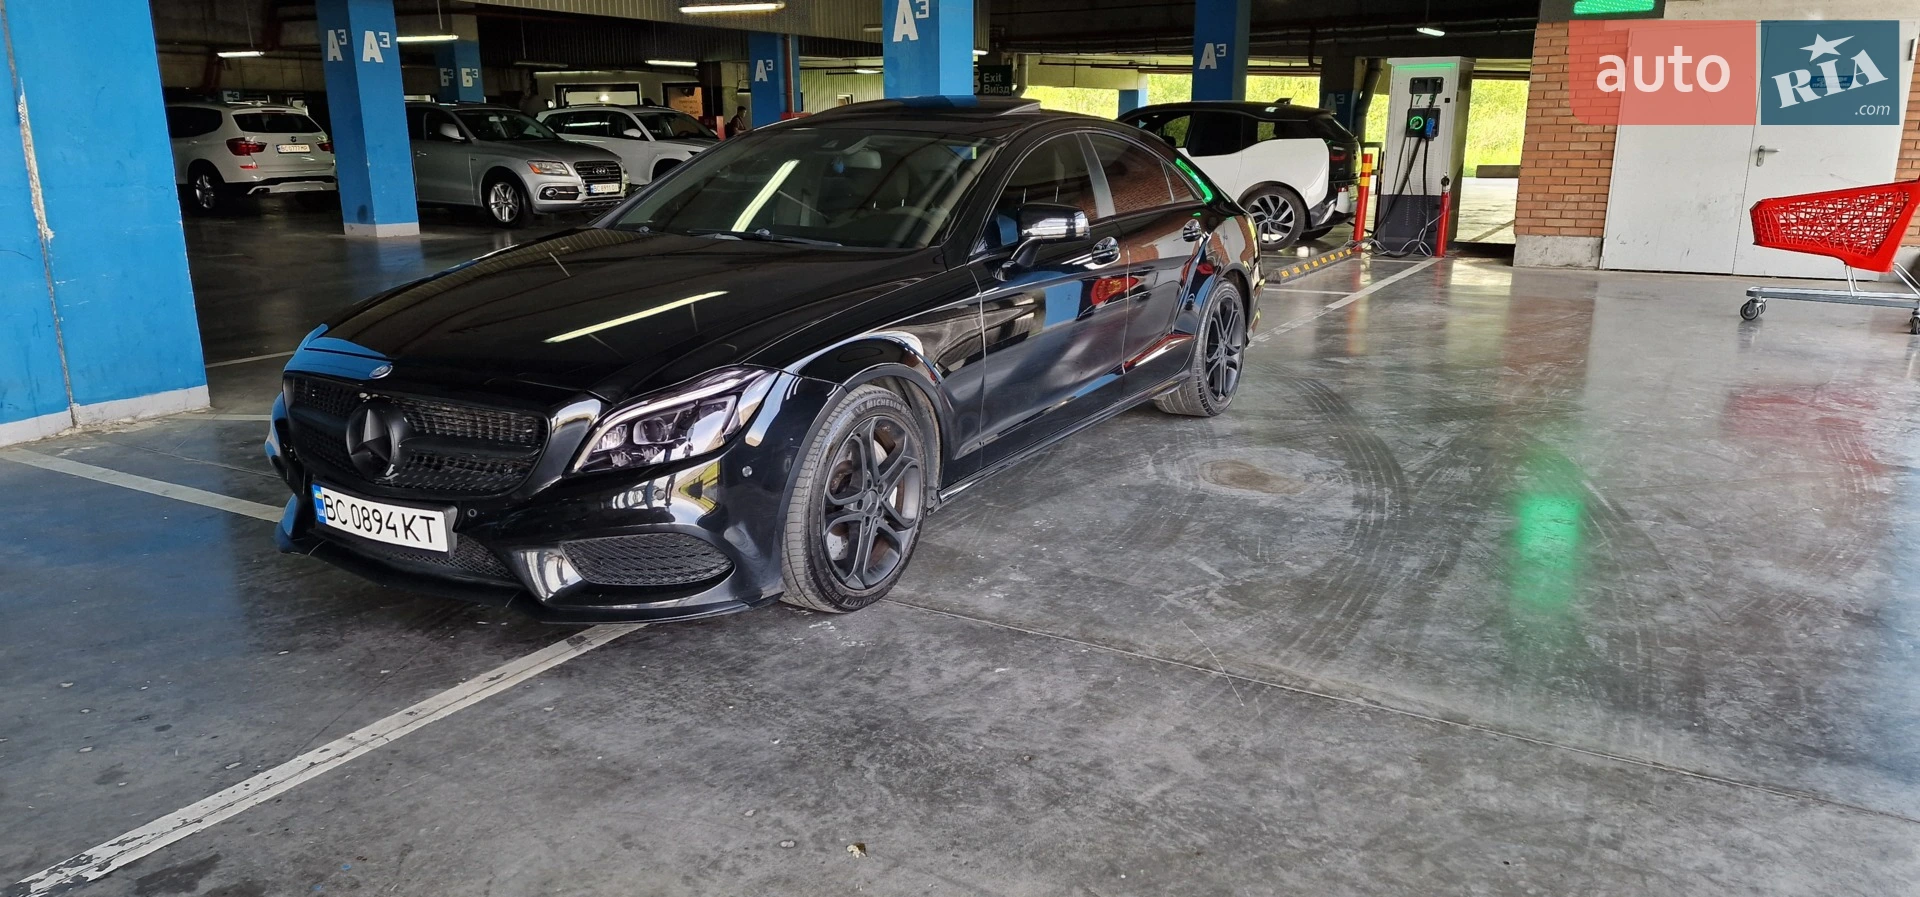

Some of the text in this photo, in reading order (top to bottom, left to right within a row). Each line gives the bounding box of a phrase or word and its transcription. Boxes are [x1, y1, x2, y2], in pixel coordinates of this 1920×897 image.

[983, 73, 1002, 83] Exit
[983, 84, 1010, 94] Виїзд
[323, 494, 436, 544] BC 0894 KT
